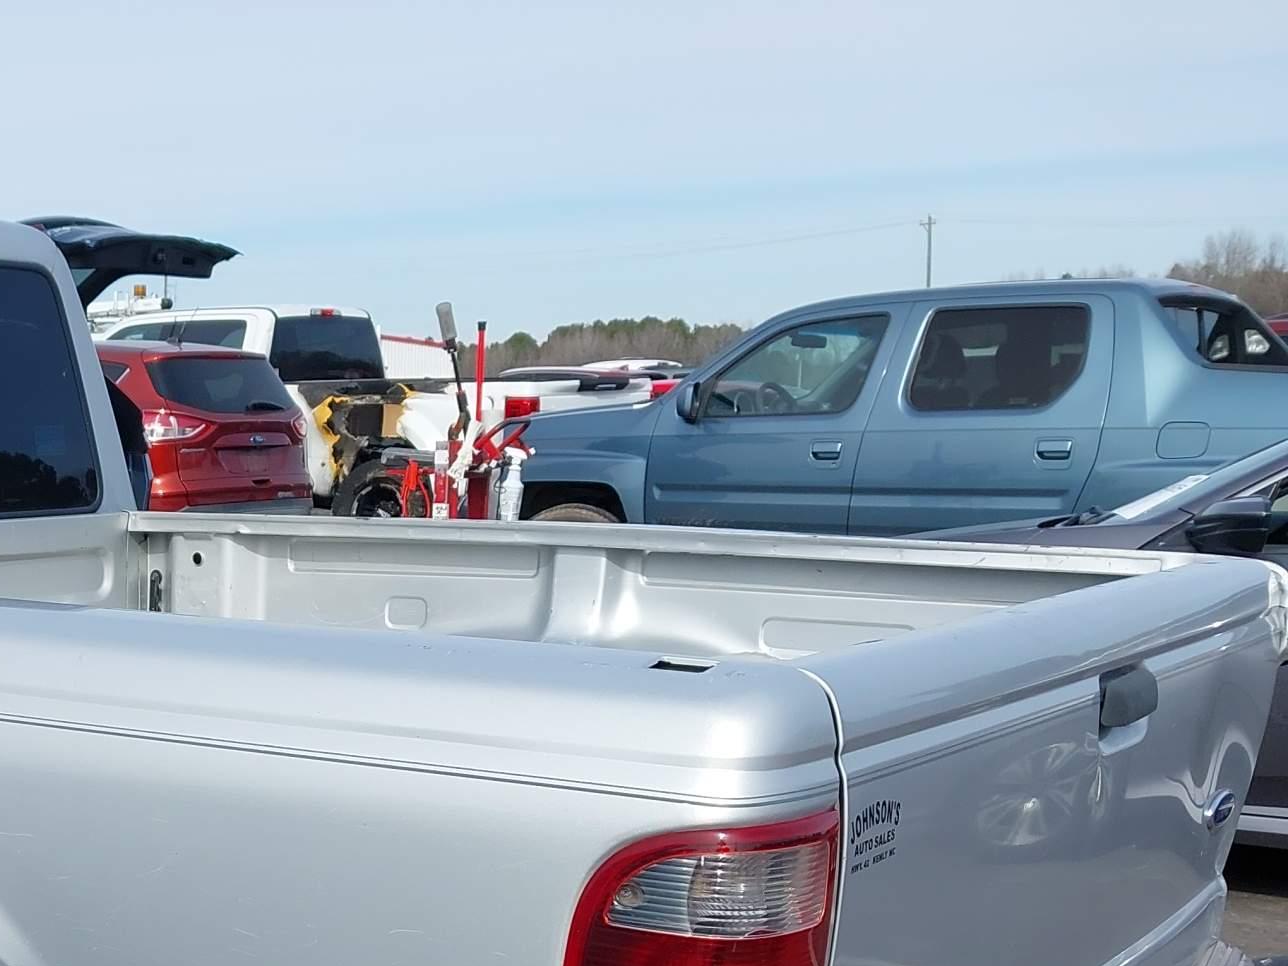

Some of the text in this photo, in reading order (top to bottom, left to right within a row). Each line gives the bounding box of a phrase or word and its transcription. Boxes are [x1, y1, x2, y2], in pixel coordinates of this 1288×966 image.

[850, 800, 901, 845] JOHNSON'S
[854, 829, 896, 858] AUTO SALES
